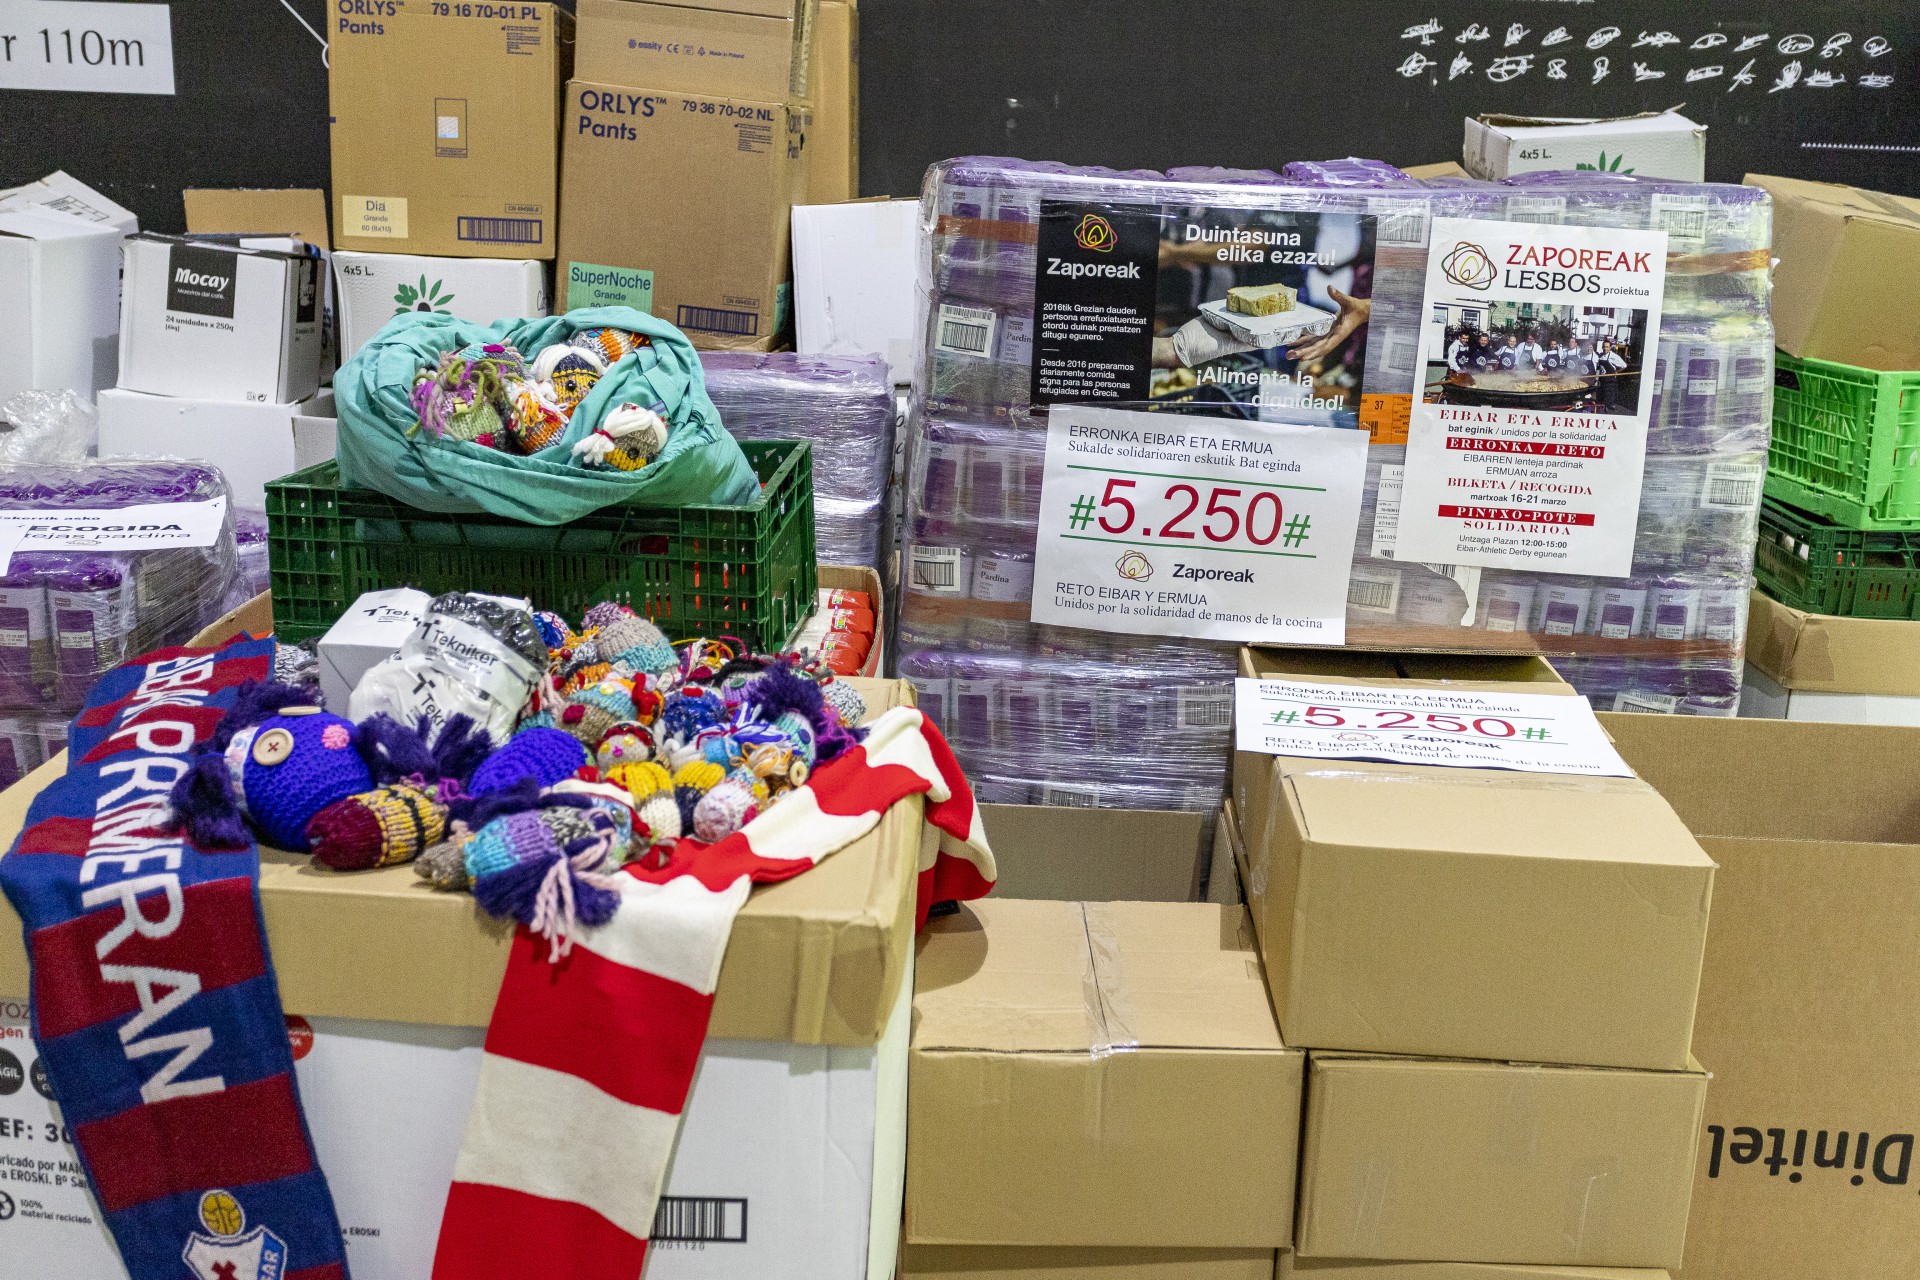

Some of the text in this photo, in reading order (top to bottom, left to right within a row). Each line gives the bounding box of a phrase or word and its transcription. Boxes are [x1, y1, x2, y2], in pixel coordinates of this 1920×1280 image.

[432, 3, 449, 16] 79
[454, 4, 470, 17] 16
[475, 5, 515, 19] 70-01
[521, 7, 541, 20] PL
[338, 18, 385, 35] Pants
[1, 29, 144, 66] r 110m
[682, 100, 697, 112] 79
[700, 102, 714, 114] 36
[719, 104, 753, 119] 70-02
[757, 109, 775, 122] NL
[578, 116, 637, 141] Pants
[1519, 149, 1539, 160] 4x5
[366, 200, 386, 211] Dia
[364, 214, 389, 222] Grande
[1186, 224, 1301, 246] Duintasuna
[1217, 244, 1336, 266] elika ezazu!
[1507, 244, 1651, 273] ZAPOREAK
[343, 265, 361, 276] 4x5
[1047, 257, 1140, 279] Zaporeak
[175, 267, 229, 292] Mocay
[571, 266, 651, 291] SuperNoche
[1504, 270, 1649, 296] LESBOS proiektua
[594, 289, 626, 301] Grande
[1044, 303, 1136, 314] 2016tik Grezian dauden
[165, 315, 174, 323] 24
[176, 318, 208, 328] unidades
[1043, 322, 1140, 333] otordu duinak prestatzen
[1080, 315, 1146, 324] errefuxiatuentzat
[1042, 331, 1067, 340] ditugu
[1040, 359, 1065, 367] Desde
[1088, 362, 1134, 370] preparamos
[1040, 368, 1115, 379] diariamente comida
[1197, 367, 1313, 388] ¡Alimenta la
[1040, 378, 1060, 386] digna
[1040, 386, 1078, 395] refugiadas
[1093, 389, 1119, 397] Grecia.
[1251, 393, 1344, 411] dignidad!
[1374, 400, 1384, 410] 37
[1440, 410, 1618, 431] EIBAR ETA ERMUA
[1069, 425, 1273, 455] ERRONKA EIBAR ETA ERMUA
[1448, 424, 1606, 442] bat eginik unidos por la solidaridad
[1450, 438, 1601, 457] ERRONKA RETO
[1068, 439, 1301, 473] Sukalde solidarioaren eskutik Bat eginda
[1463, 454, 1583, 469] EIBARREN lenteja pardinak
[1486, 467, 1558, 479] ERMUAN arroza
[1448, 477, 1592, 495] BILKETA RECOGIDA
[1471, 494, 1567, 506] martxoak 16-21 marzo
[1457, 506, 1577, 524] PINTXO-POTE
[1463, 521, 1571, 536] SOLIDARIOA
[1459, 534, 1567, 549] Untzaga Plazan 12:00-15:00
[1457, 544, 1567, 559] Eibar-Athletic Derby egunean
[981, 571, 1009, 583] Pardina
[1172, 563, 1254, 583] Zaporeak
[1056, 581, 1207, 606] RETO EIBAR Y ERMUA
[1055, 596, 1323, 629] Unidos por la solidaridad de manos de la cocina
[432, 629, 499, 666] Tekniker
[1260, 684, 1336, 695] ERRONKA
[1341, 691, 1387, 699] EIBAR
[1427, 695, 1485, 704] ERMUA
[1260, 689, 1310, 699] Sukalde
[1314, 695, 1396, 706] solidarioaren
[1400, 700, 1445, 708] eskutik
[1476, 705, 1520, 713] eginda
[1265, 736, 1311, 745] RETO
[1389, 743, 1452, 752] ERMUA
[1402, 734, 1502, 749] Zaporeak
[1265, 742, 1314, 751] Unidos
[1363, 747, 1439, 758] solidaridad
[1465, 754, 1511, 763] manos
[1707, 1125, 1915, 1186] Dinitel
[38, 1160, 55, 1171] por
[10, 1169, 52, 1185] EROSKI.
[20, 1199, 43, 1209] 100%
[21, 1210, 92, 1224] material reciclado
[350, 1228, 380, 1237] EROSKI
